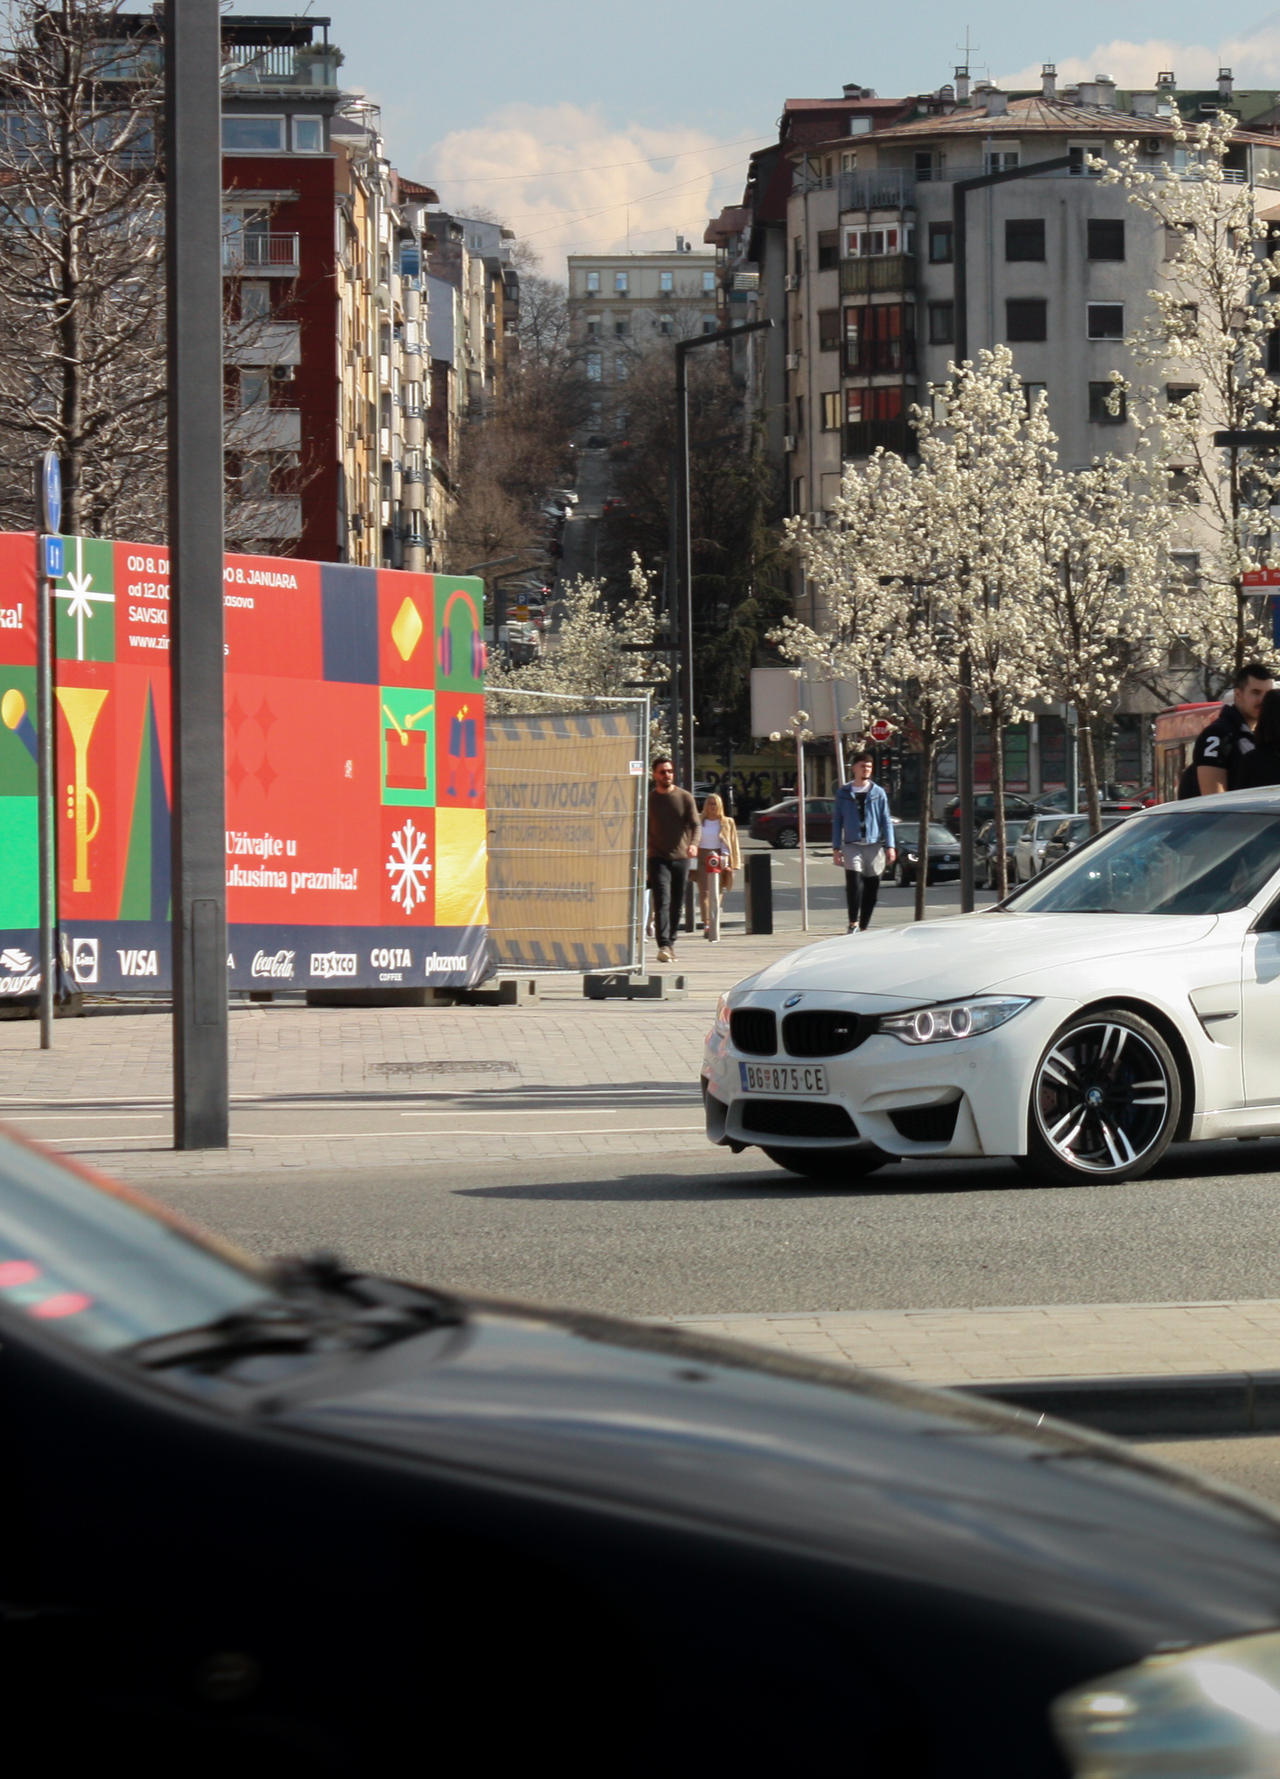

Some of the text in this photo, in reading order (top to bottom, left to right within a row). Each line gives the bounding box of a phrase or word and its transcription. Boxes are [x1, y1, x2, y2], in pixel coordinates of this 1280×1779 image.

[127, 555, 145, 572] OD
[146, 558, 157, 573] 8.
[128, 582, 142, 597] od
[236, 568, 246, 584] 8.
[247, 570, 298, 590] JANUARA
[128, 606, 168, 625] SAVSKI
[1203, 736, 1220, 758] 2
[286, 839, 297, 857] u
[291, 867, 358, 894] praznika!
[116, 950, 159, 976] VISA
[312, 953, 355, 976] DEXYCO
[370, 948, 412, 970] COSTA
[425, 951, 468, 977] plazma
[379, 972, 403, 982] COFFEE
[748, 1067, 764, 1089] BG
